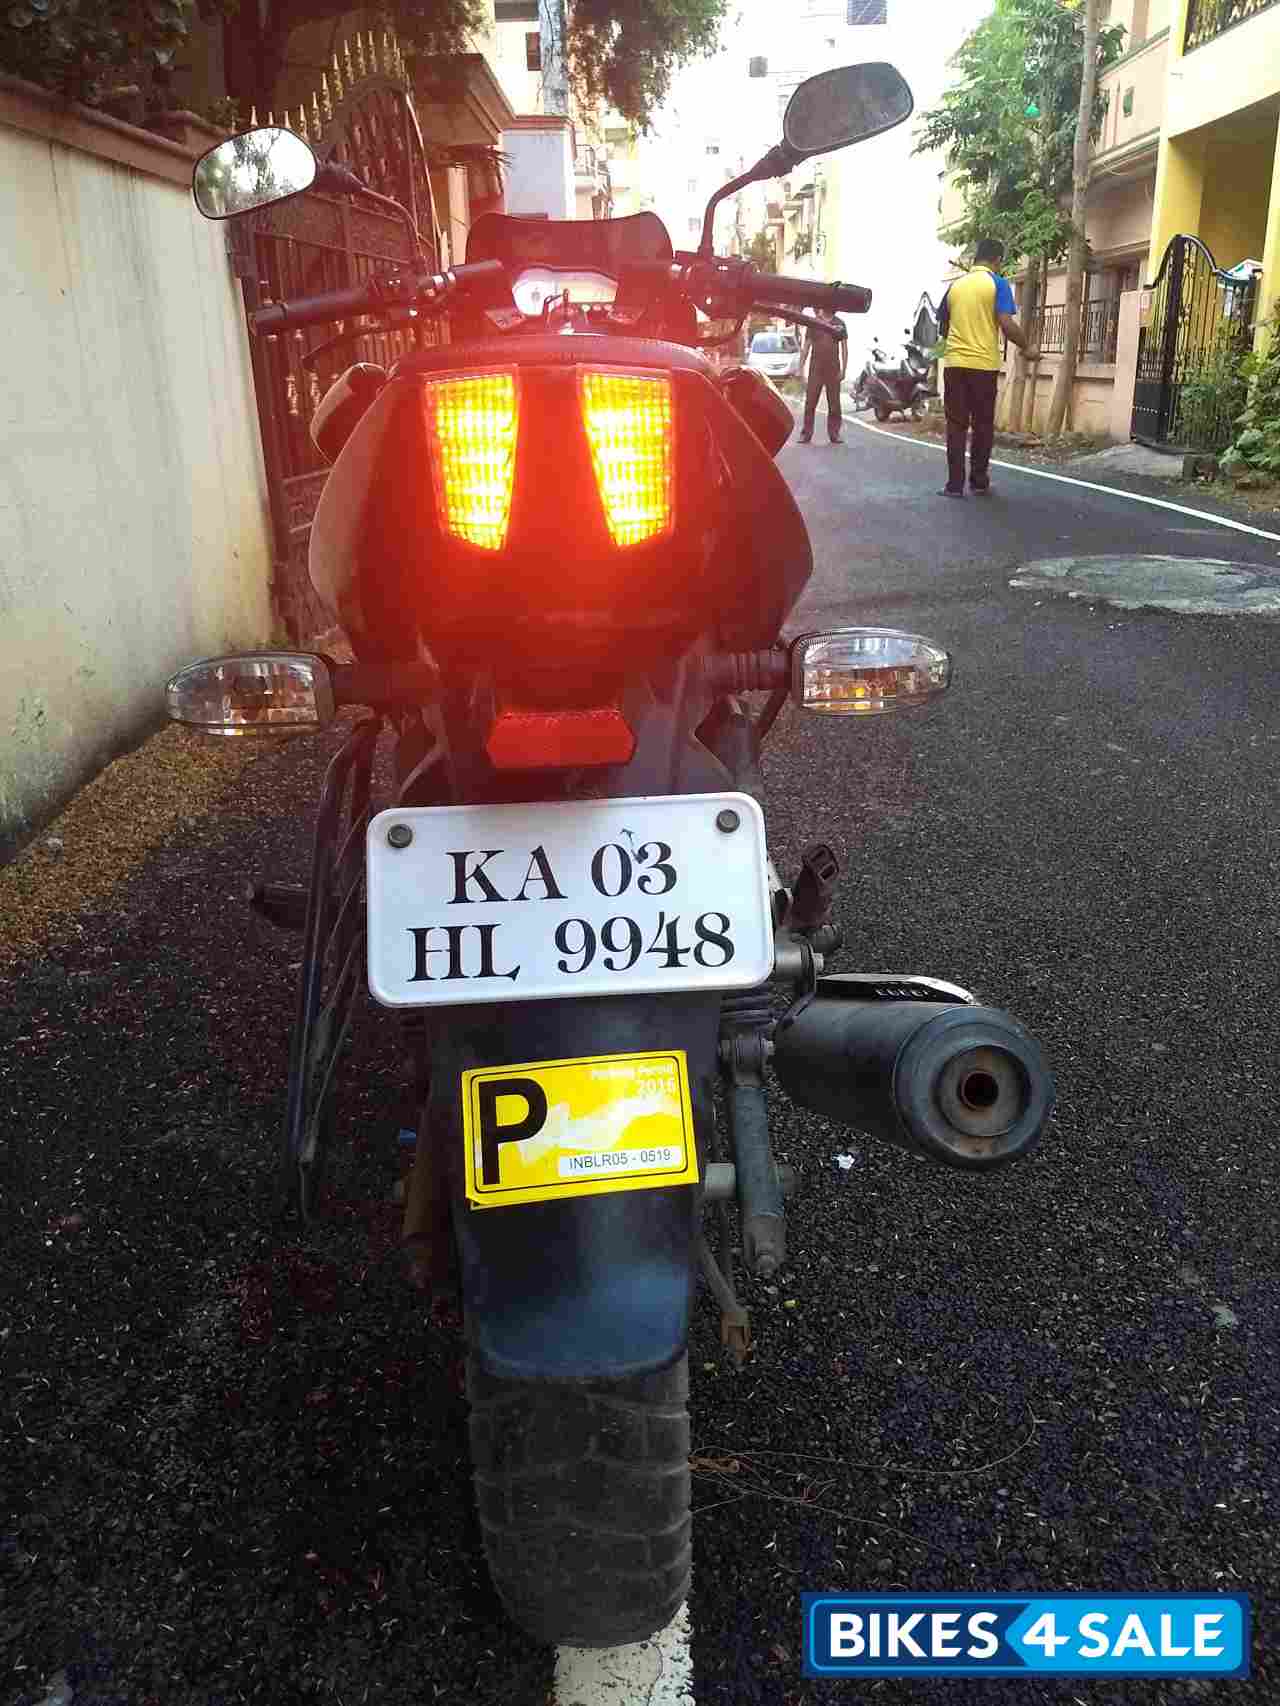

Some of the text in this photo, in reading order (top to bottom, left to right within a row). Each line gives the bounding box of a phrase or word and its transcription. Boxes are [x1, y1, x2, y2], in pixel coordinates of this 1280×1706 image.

[446, 841, 677, 904] KA 03
[407, 911, 735, 982] HL 9948
[478, 1078, 547, 1184] P
[568, 1154, 629, 1169] INBLR05
